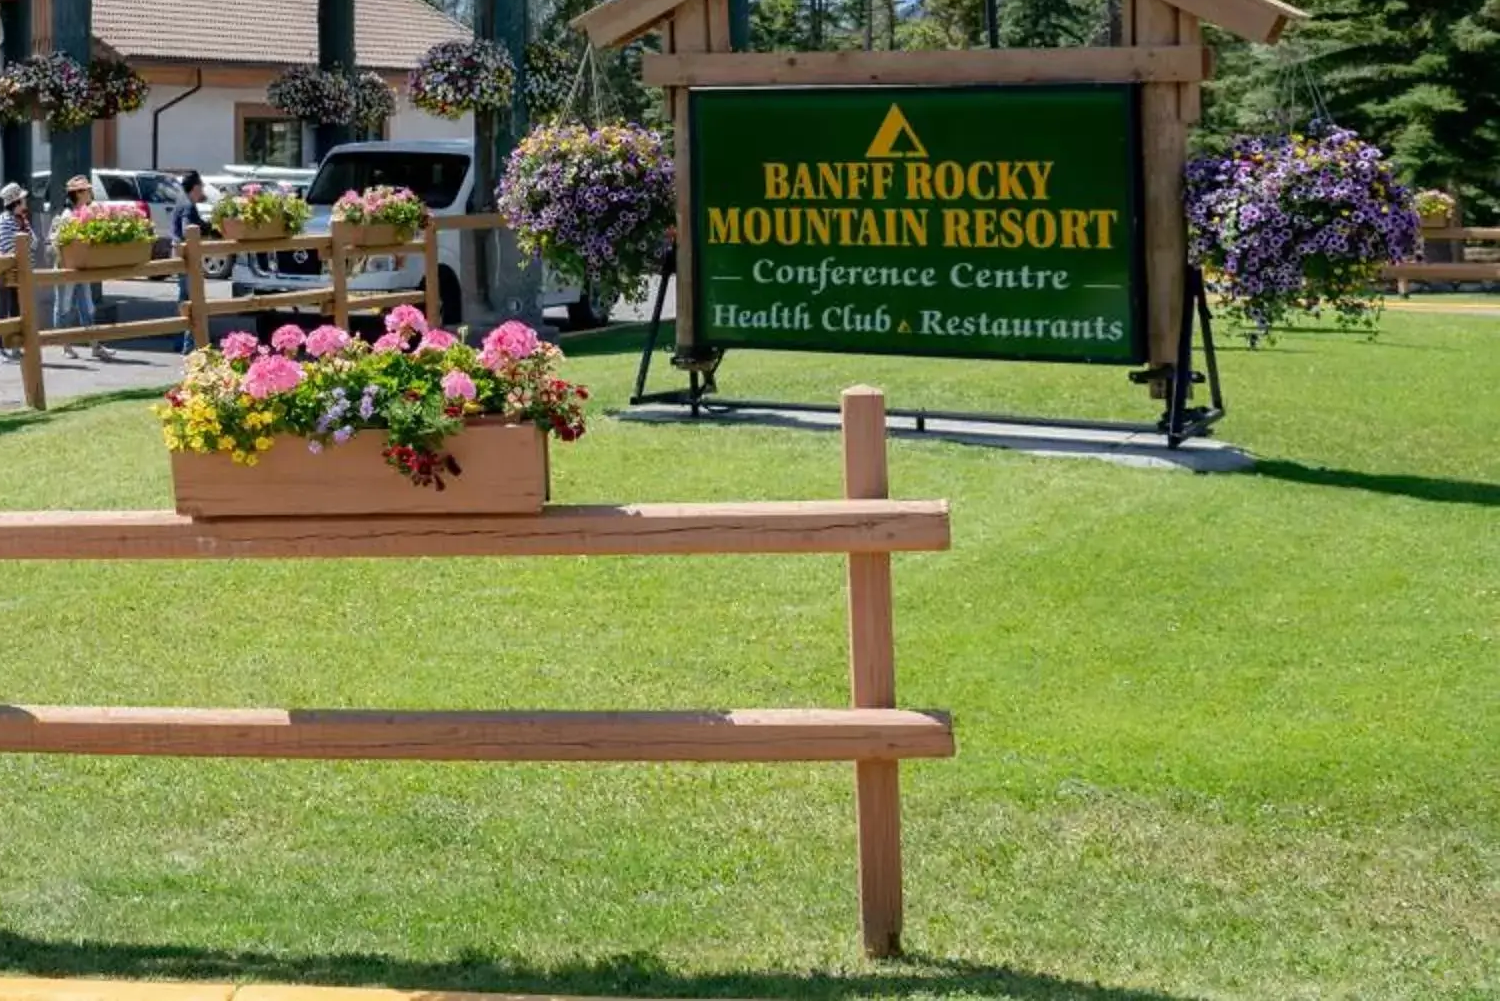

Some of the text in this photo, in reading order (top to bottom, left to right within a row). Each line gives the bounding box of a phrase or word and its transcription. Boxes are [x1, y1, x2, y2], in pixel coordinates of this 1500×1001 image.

[763, 160, 1054, 200] BANFF ROCKY
[707, 207, 1118, 249] MOUNTAIN RESORT
[752, 257, 1070, 295] Conference Centre
[712, 303, 1125, 342] Health Club Restaurants
